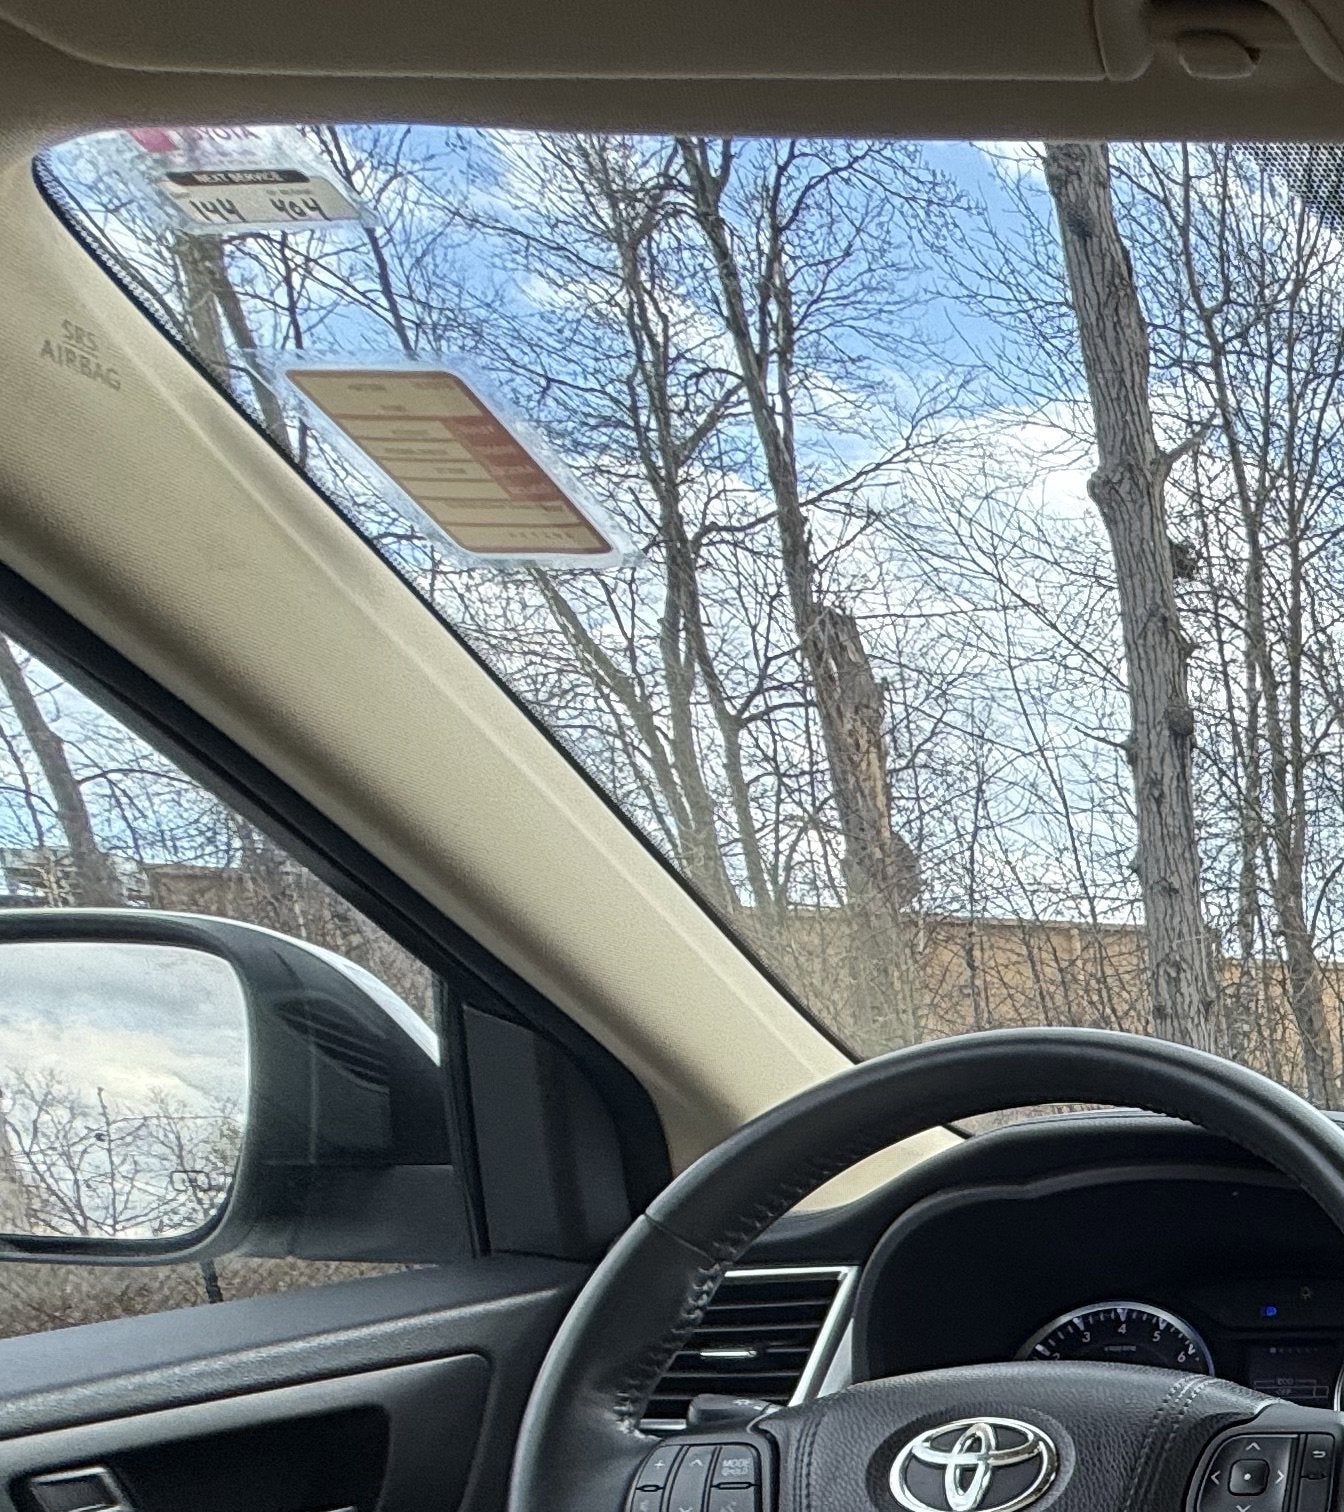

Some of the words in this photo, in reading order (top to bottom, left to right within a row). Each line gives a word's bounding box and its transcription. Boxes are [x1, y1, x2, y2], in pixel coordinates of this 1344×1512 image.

[40, 339, 121, 391] AIRBAG
[1117, 1324, 1127, 1334] 4
[1082, 1332, 1091, 1343] 3
[1152, 1331, 1162, 1342] 5
[1177, 1352, 1186, 1363] 6
